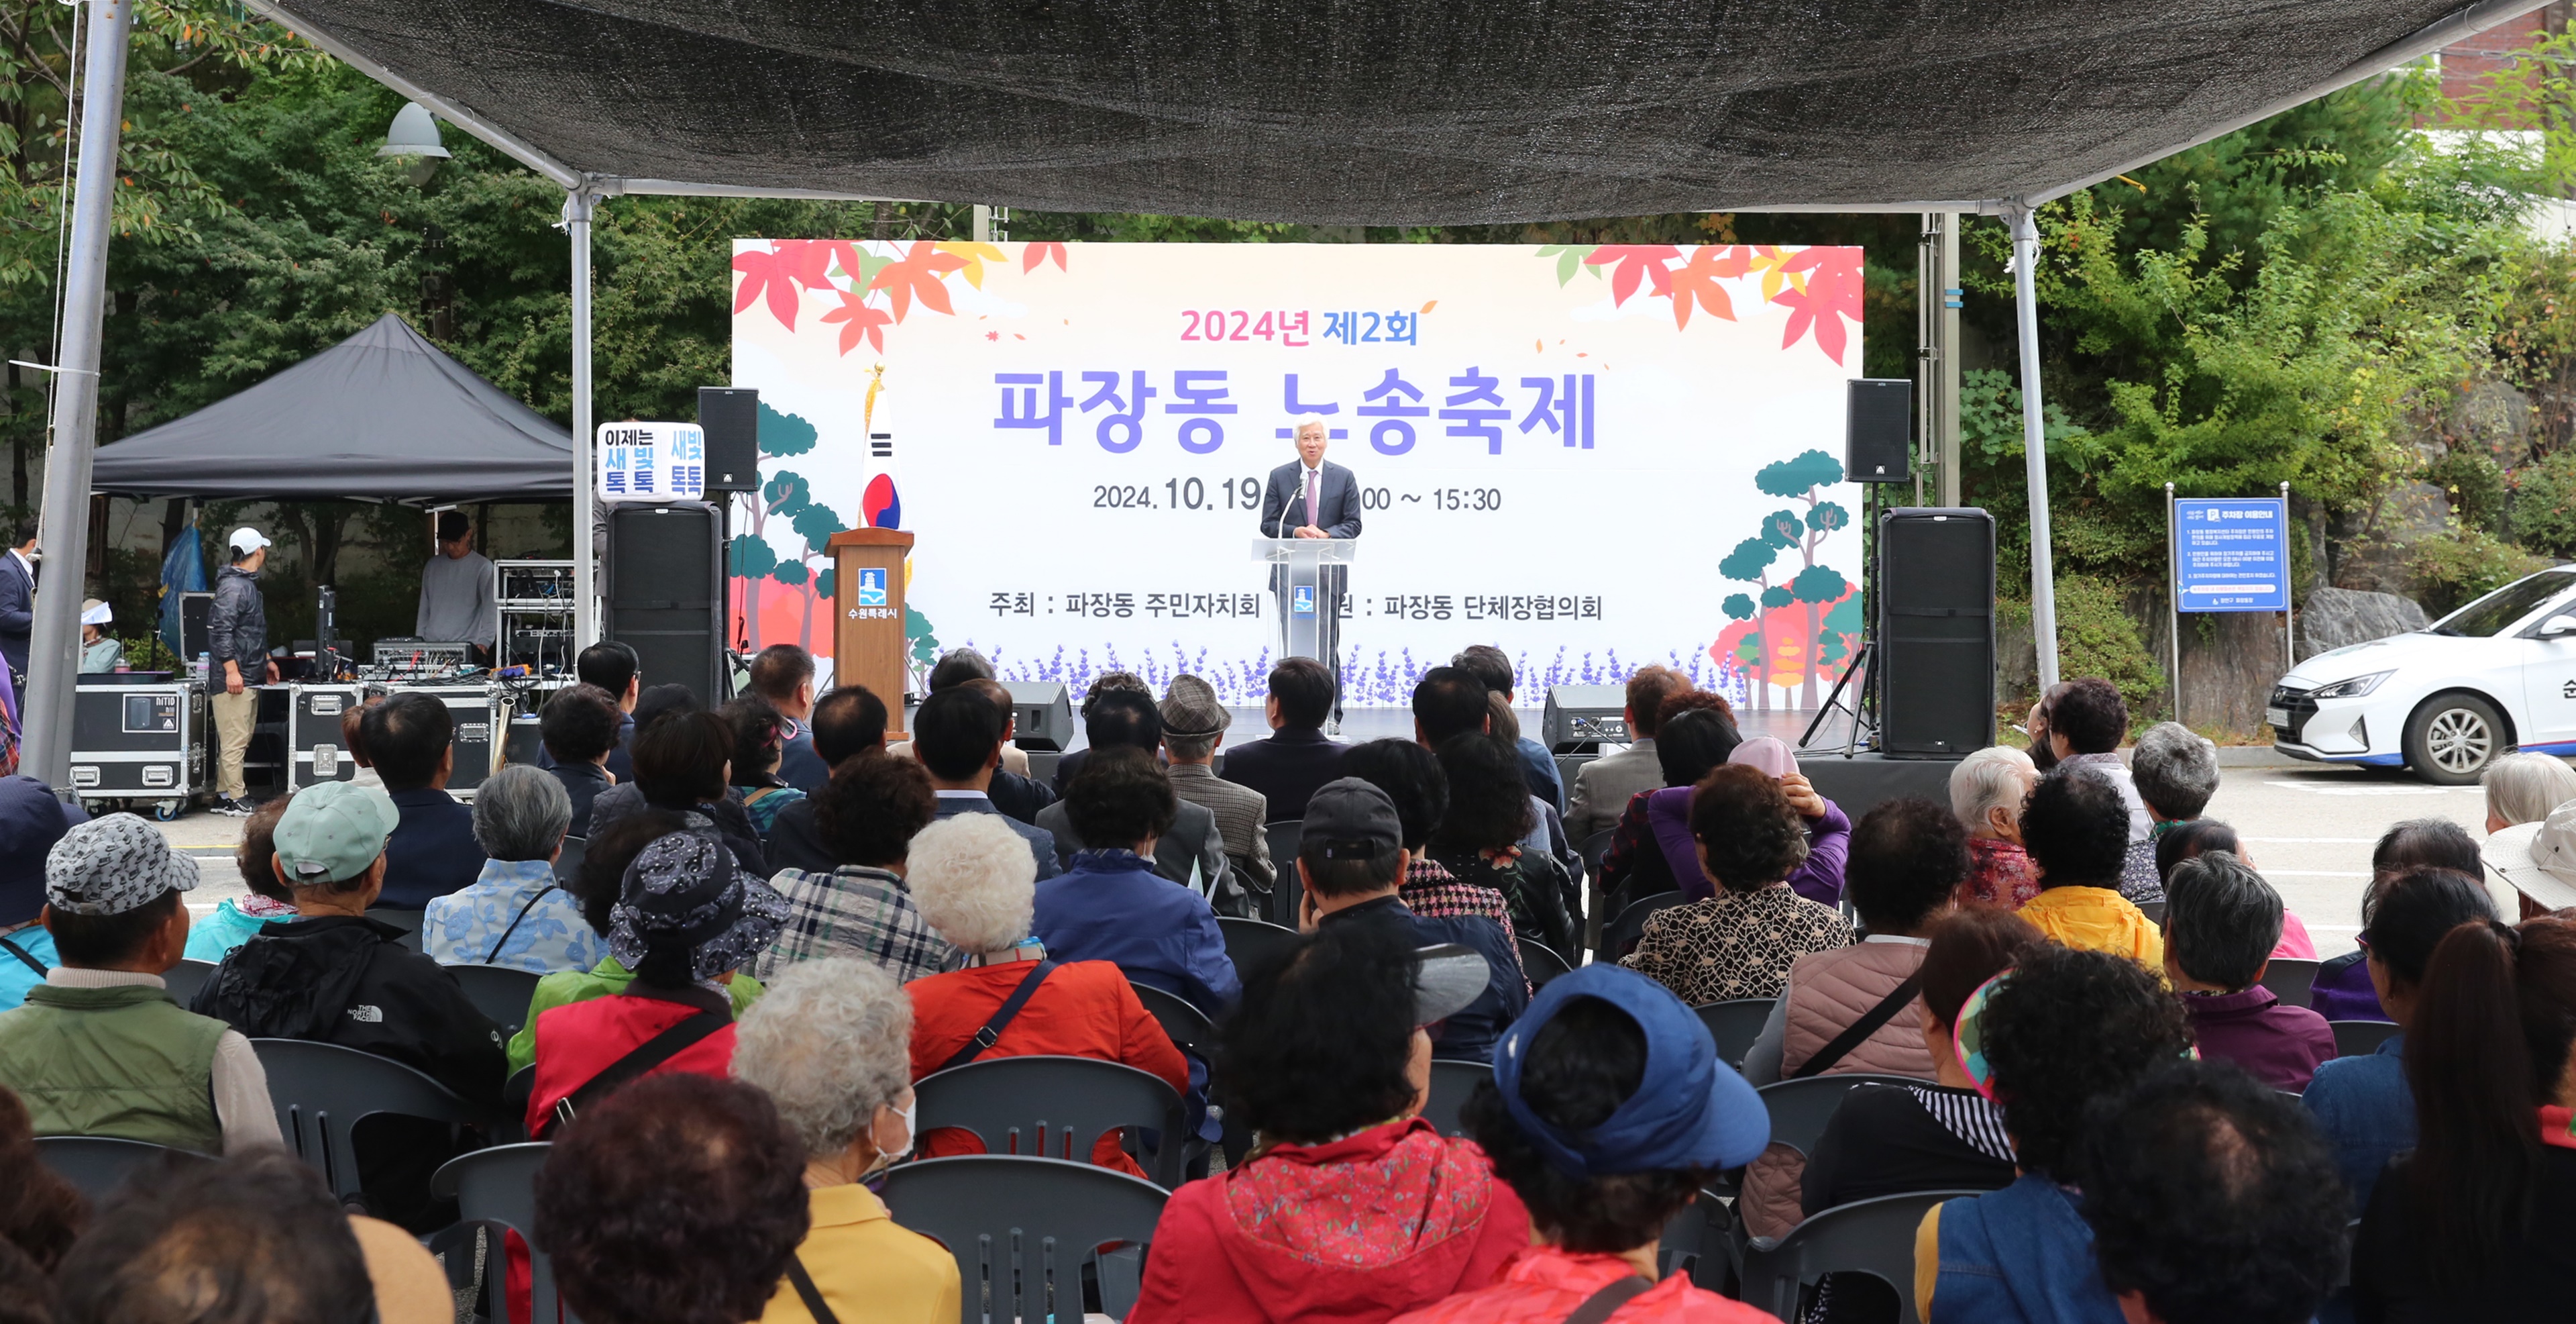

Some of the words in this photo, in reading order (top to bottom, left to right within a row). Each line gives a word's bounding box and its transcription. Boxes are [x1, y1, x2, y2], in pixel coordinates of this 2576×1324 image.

[1181, 310, 1309, 347] 2024년
[1323, 310, 1417, 346] 제2회
[994, 370, 1238, 454] 파장동
[1275, 366, 1595, 456] 노송축제
[605, 429, 653, 446] 이제는
[671, 429, 702, 460] 새빛
[605, 448, 627, 470] 새
[634, 447, 654, 470] 빛
[606, 471, 627, 494] 톡
[633, 470, 654, 493] 톡
[671, 465, 702, 495] 톡톡
[1434, 489, 1501, 511] 15:30
[2222, 510, 2243, 519] 주차장
[2245, 510, 2273, 519] 이용안내
[848, 608, 898, 619] 수원특례시
[989, 592, 1034, 617] 주최
[1066, 592, 1135, 618] 파장동
[1145, 593, 1259, 618] 주민자치회
[1338, 595, 1353, 619] 원
[1385, 594, 1454, 620] 파장동
[1464, 595, 1601, 621] 단체장협의회
[347, 1009, 371, 1017] NORTH
